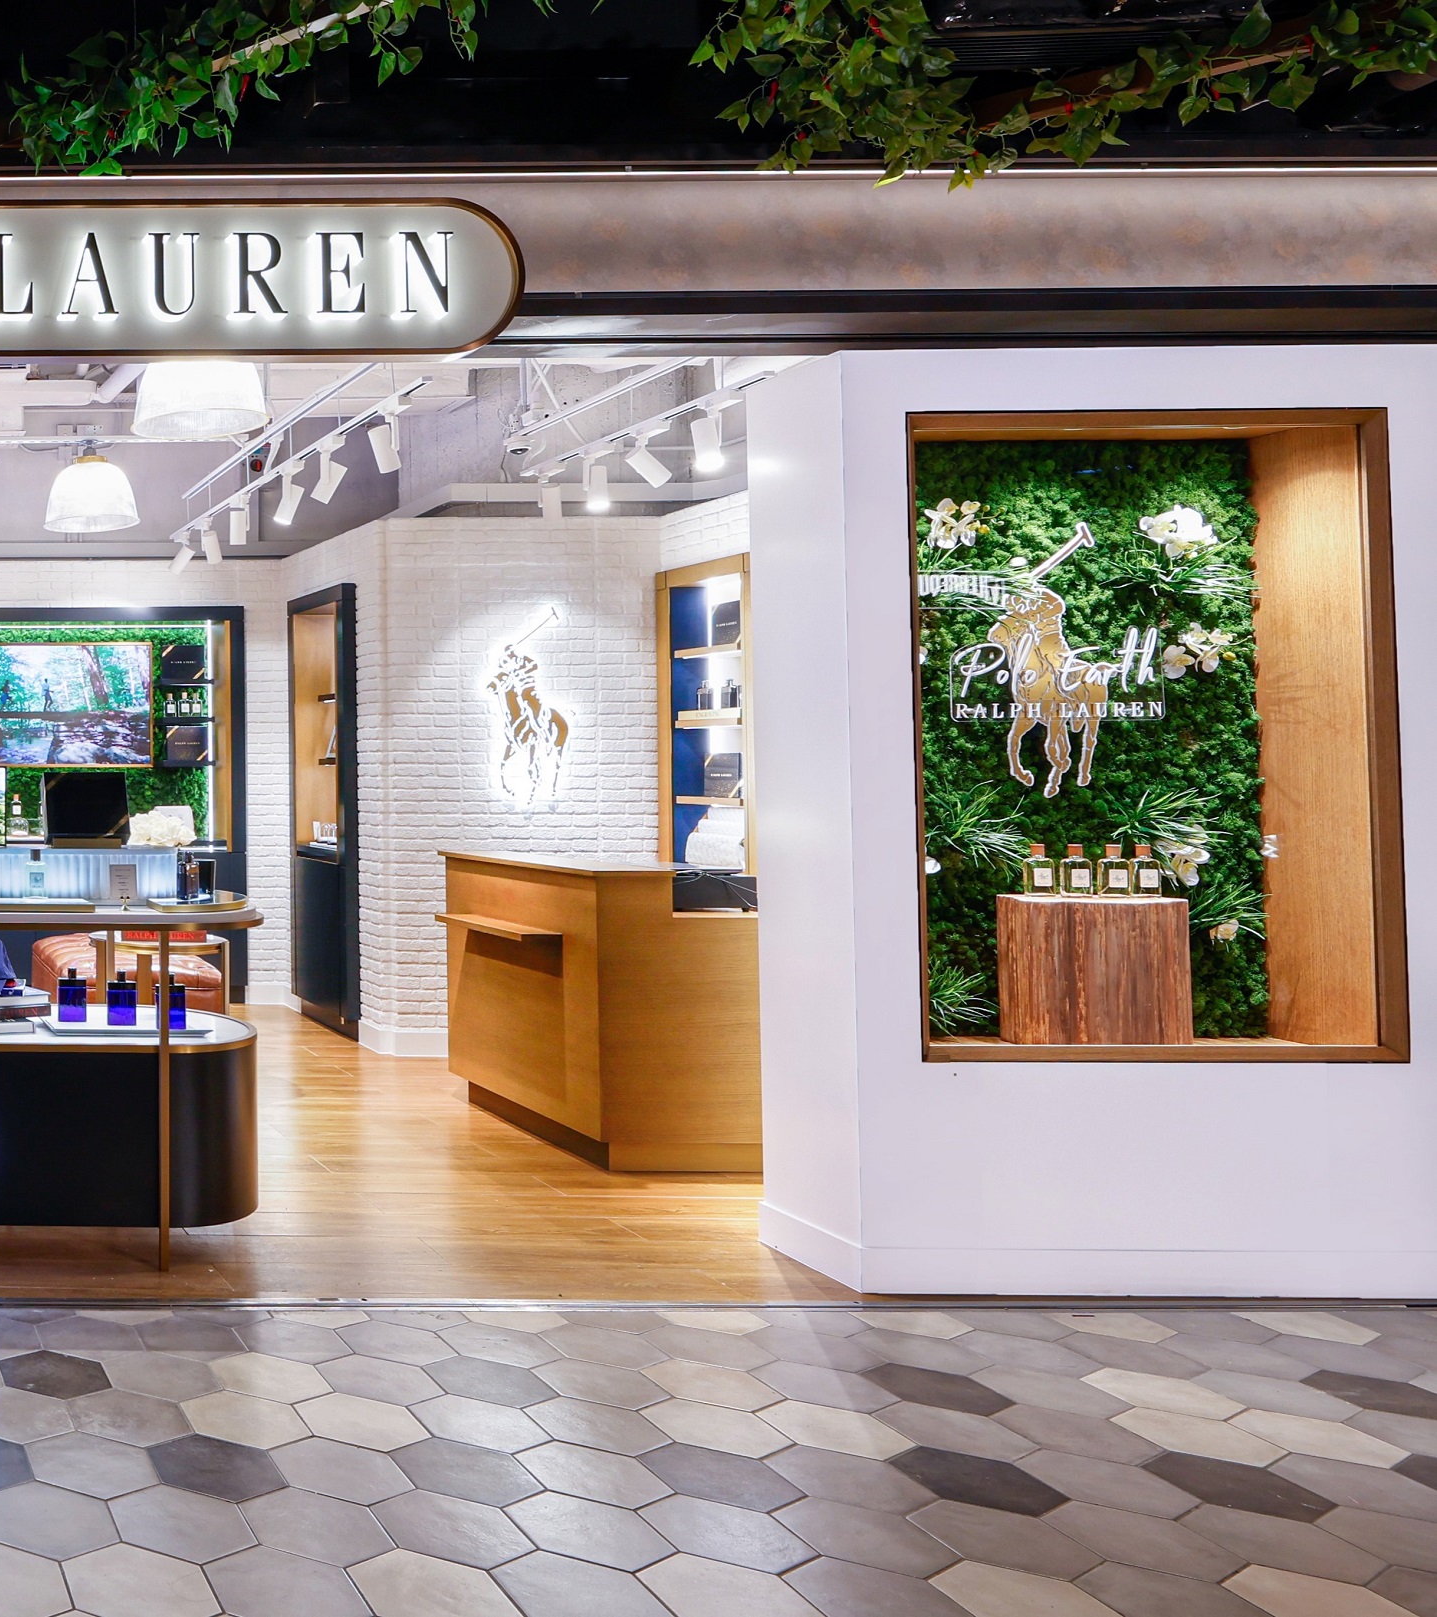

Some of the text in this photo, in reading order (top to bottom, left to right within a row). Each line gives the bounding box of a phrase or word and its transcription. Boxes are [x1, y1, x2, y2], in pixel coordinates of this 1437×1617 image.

[953, 625, 1158, 698] Polo Earth
[955, 701, 1163, 719] RALPH LAUREN
